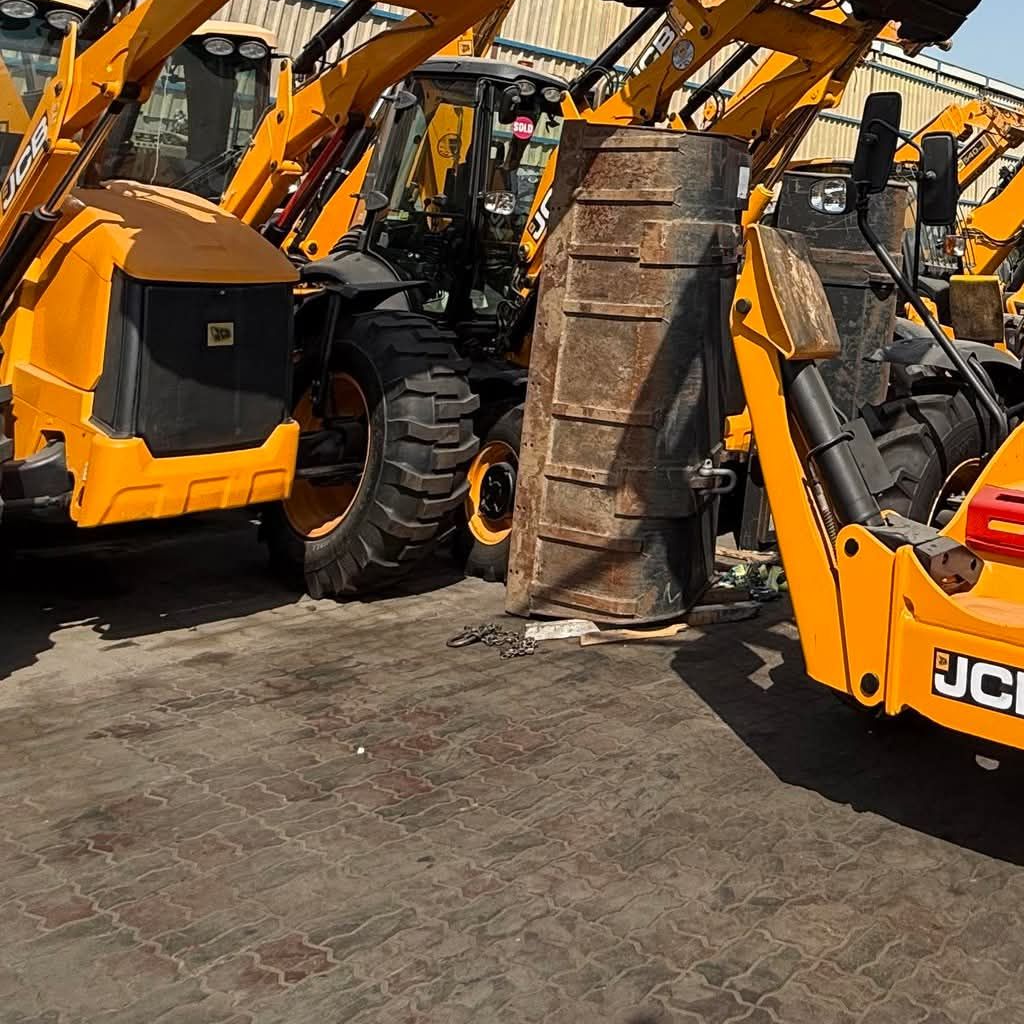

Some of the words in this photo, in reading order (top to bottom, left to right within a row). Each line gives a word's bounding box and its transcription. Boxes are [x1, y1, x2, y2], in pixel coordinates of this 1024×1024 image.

[633, 26, 676, 76] CB
[513, 121, 534, 134] SOLD
[3, 116, 48, 210] JCB
